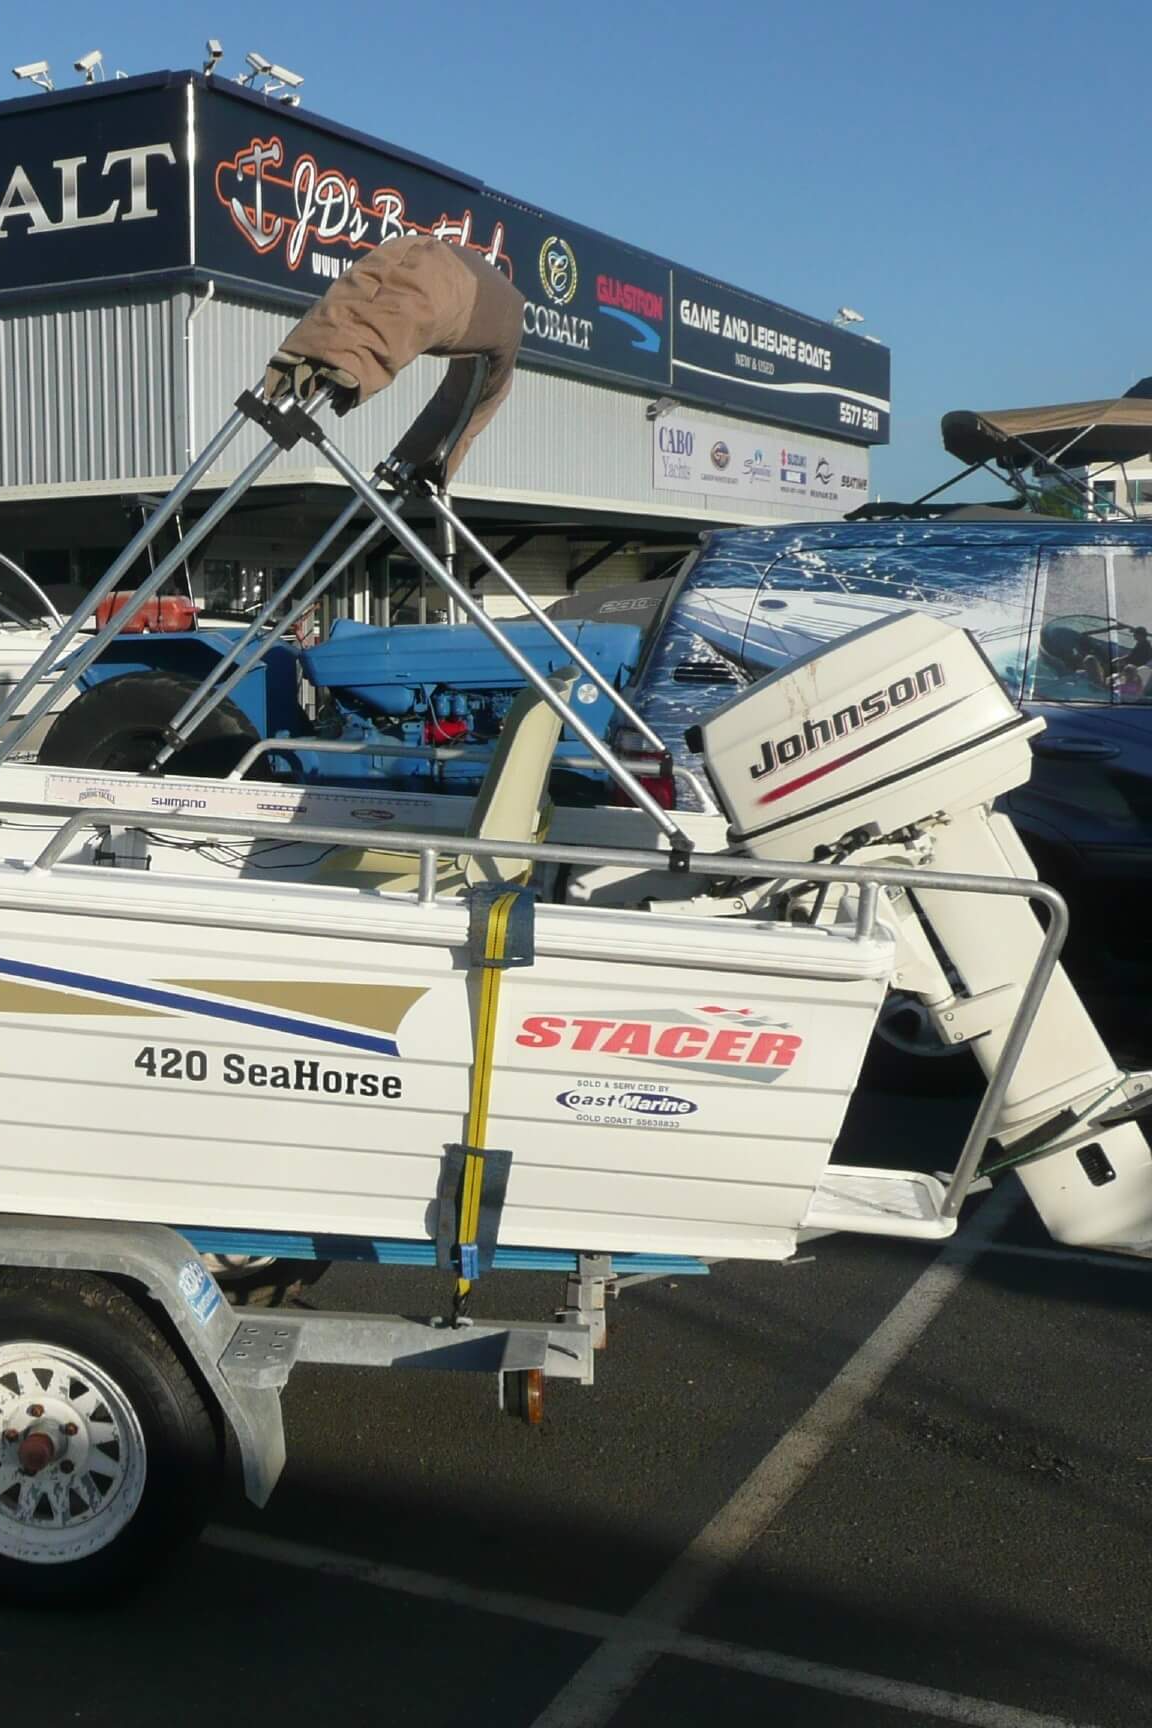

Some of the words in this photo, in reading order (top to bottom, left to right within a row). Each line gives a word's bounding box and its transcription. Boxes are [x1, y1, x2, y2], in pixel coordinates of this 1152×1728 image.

[596, 273, 664, 321] GLASTRON
[523, 301, 593, 350] COBALT
[680, 299, 720, 335] GAME
[722, 314, 748, 344] AND
[752, 323, 797, 360] LEISURE
[798, 340, 832, 372] BOATS
[735, 352, 752, 368] NEW
[659, 426, 693, 457] CABO
[749, 662, 946, 782] Johnson
[152, 796, 206, 809] SHIMANO
[515, 1016, 803, 1066] STACER
[134, 1046, 208, 1082] 420
[223, 1053, 403, 1099] SeaHorse
[577, 1079, 601, 1088] SOLD
[613, 1082, 656, 1092] SERVCED
[658, 1085, 670, 1093] BY
[576, 1113, 601, 1122] GOLD
[604, 1116, 632, 1126] COAST
[620, 1094, 691, 1114] Marine
